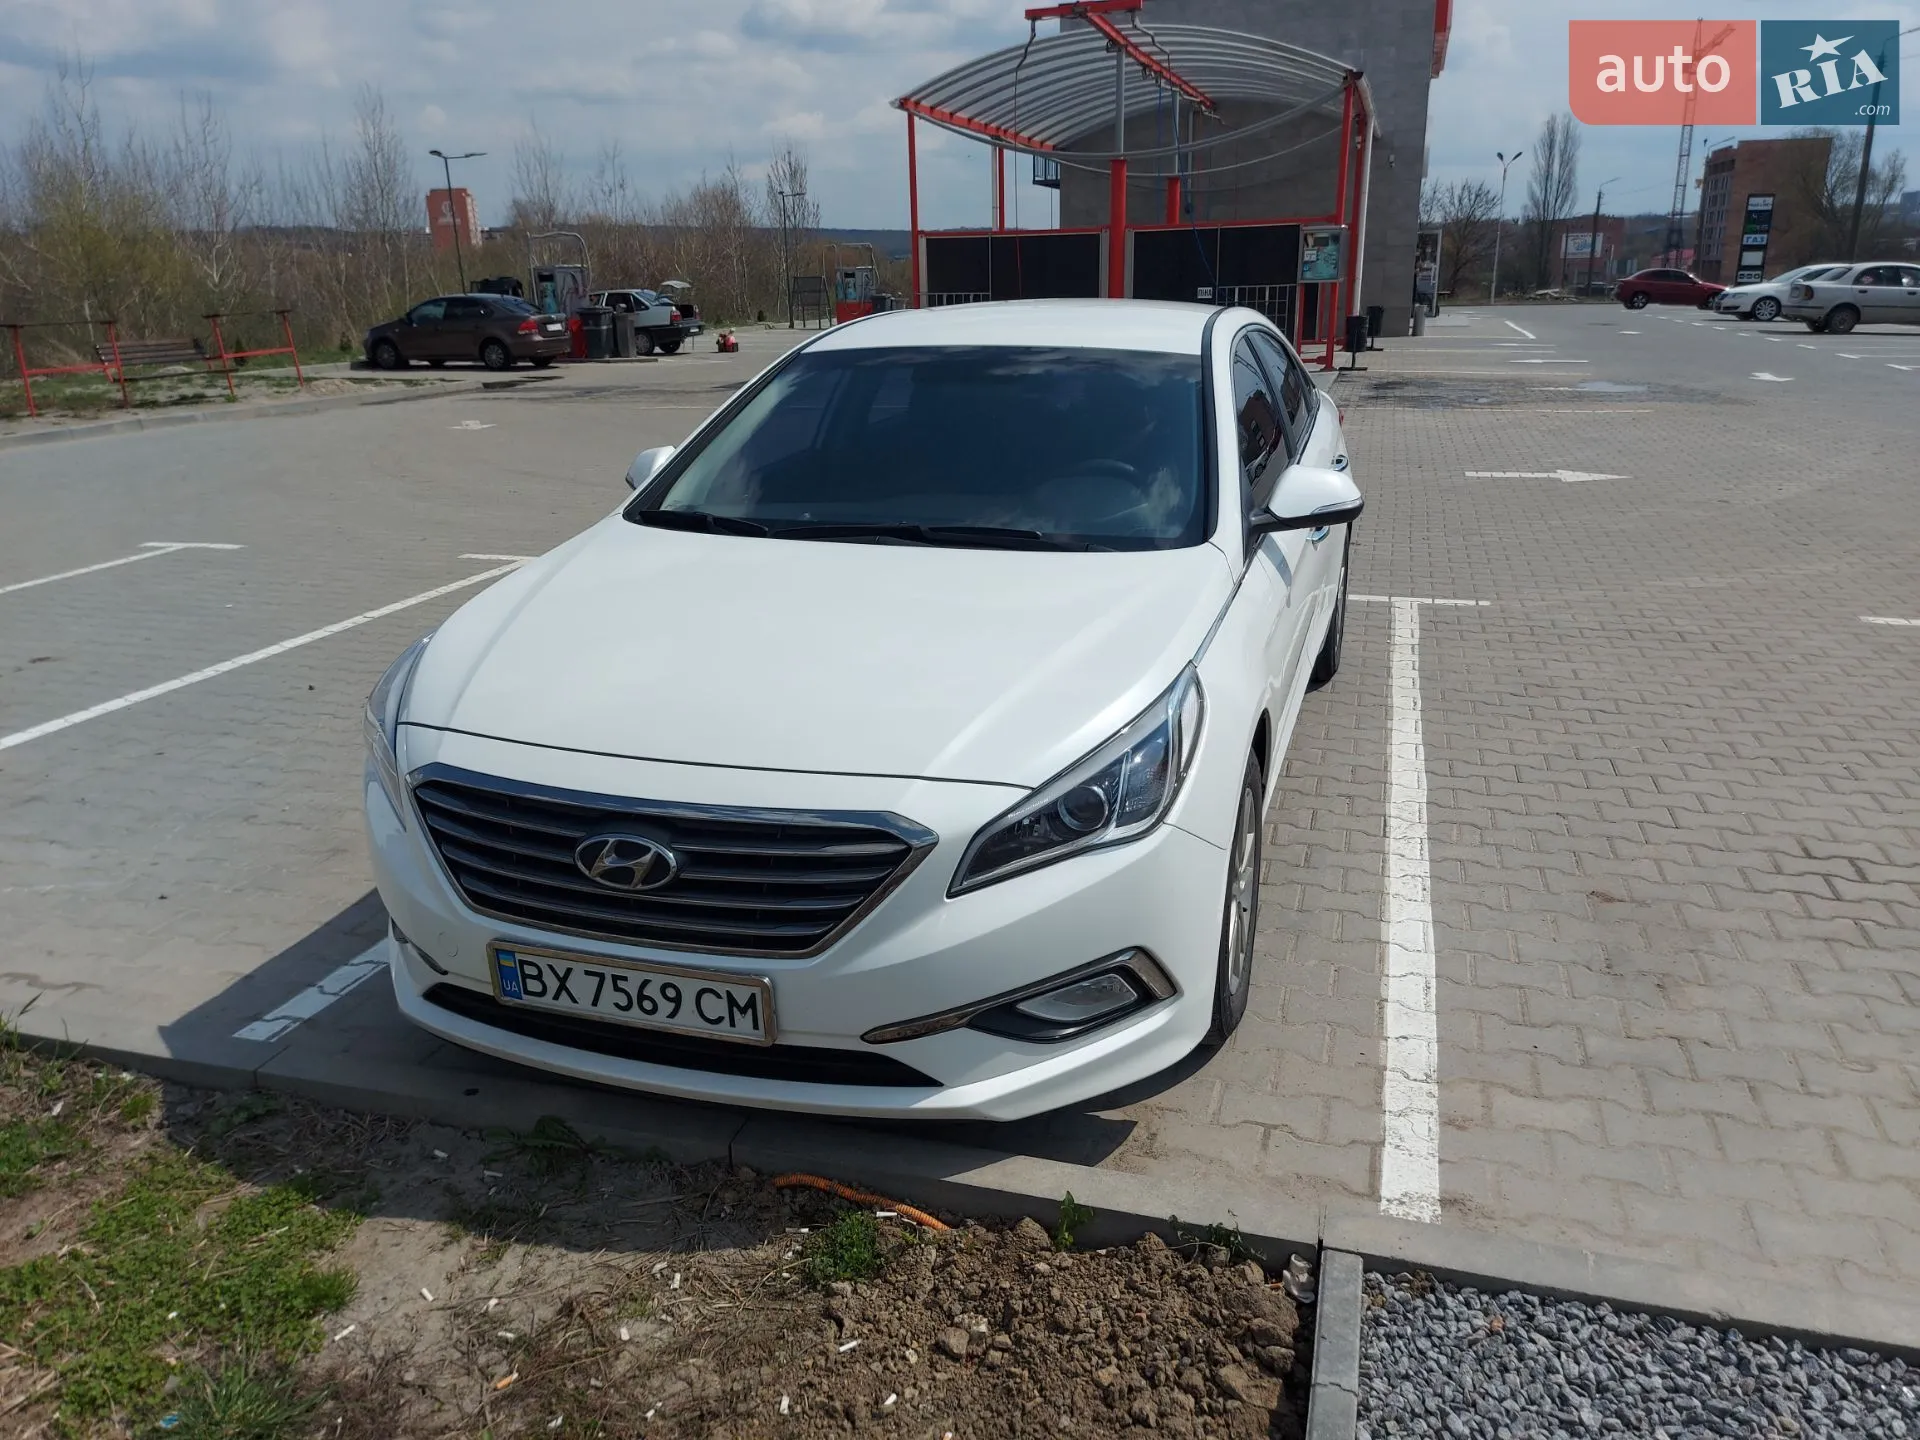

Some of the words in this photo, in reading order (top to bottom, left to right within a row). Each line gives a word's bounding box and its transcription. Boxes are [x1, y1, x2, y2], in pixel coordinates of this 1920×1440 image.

[502, 978, 519, 993] UA
[517, 959, 579, 1005] BX
[583, 969, 682, 1019] 7569
[695, 987, 759, 1031] CM
